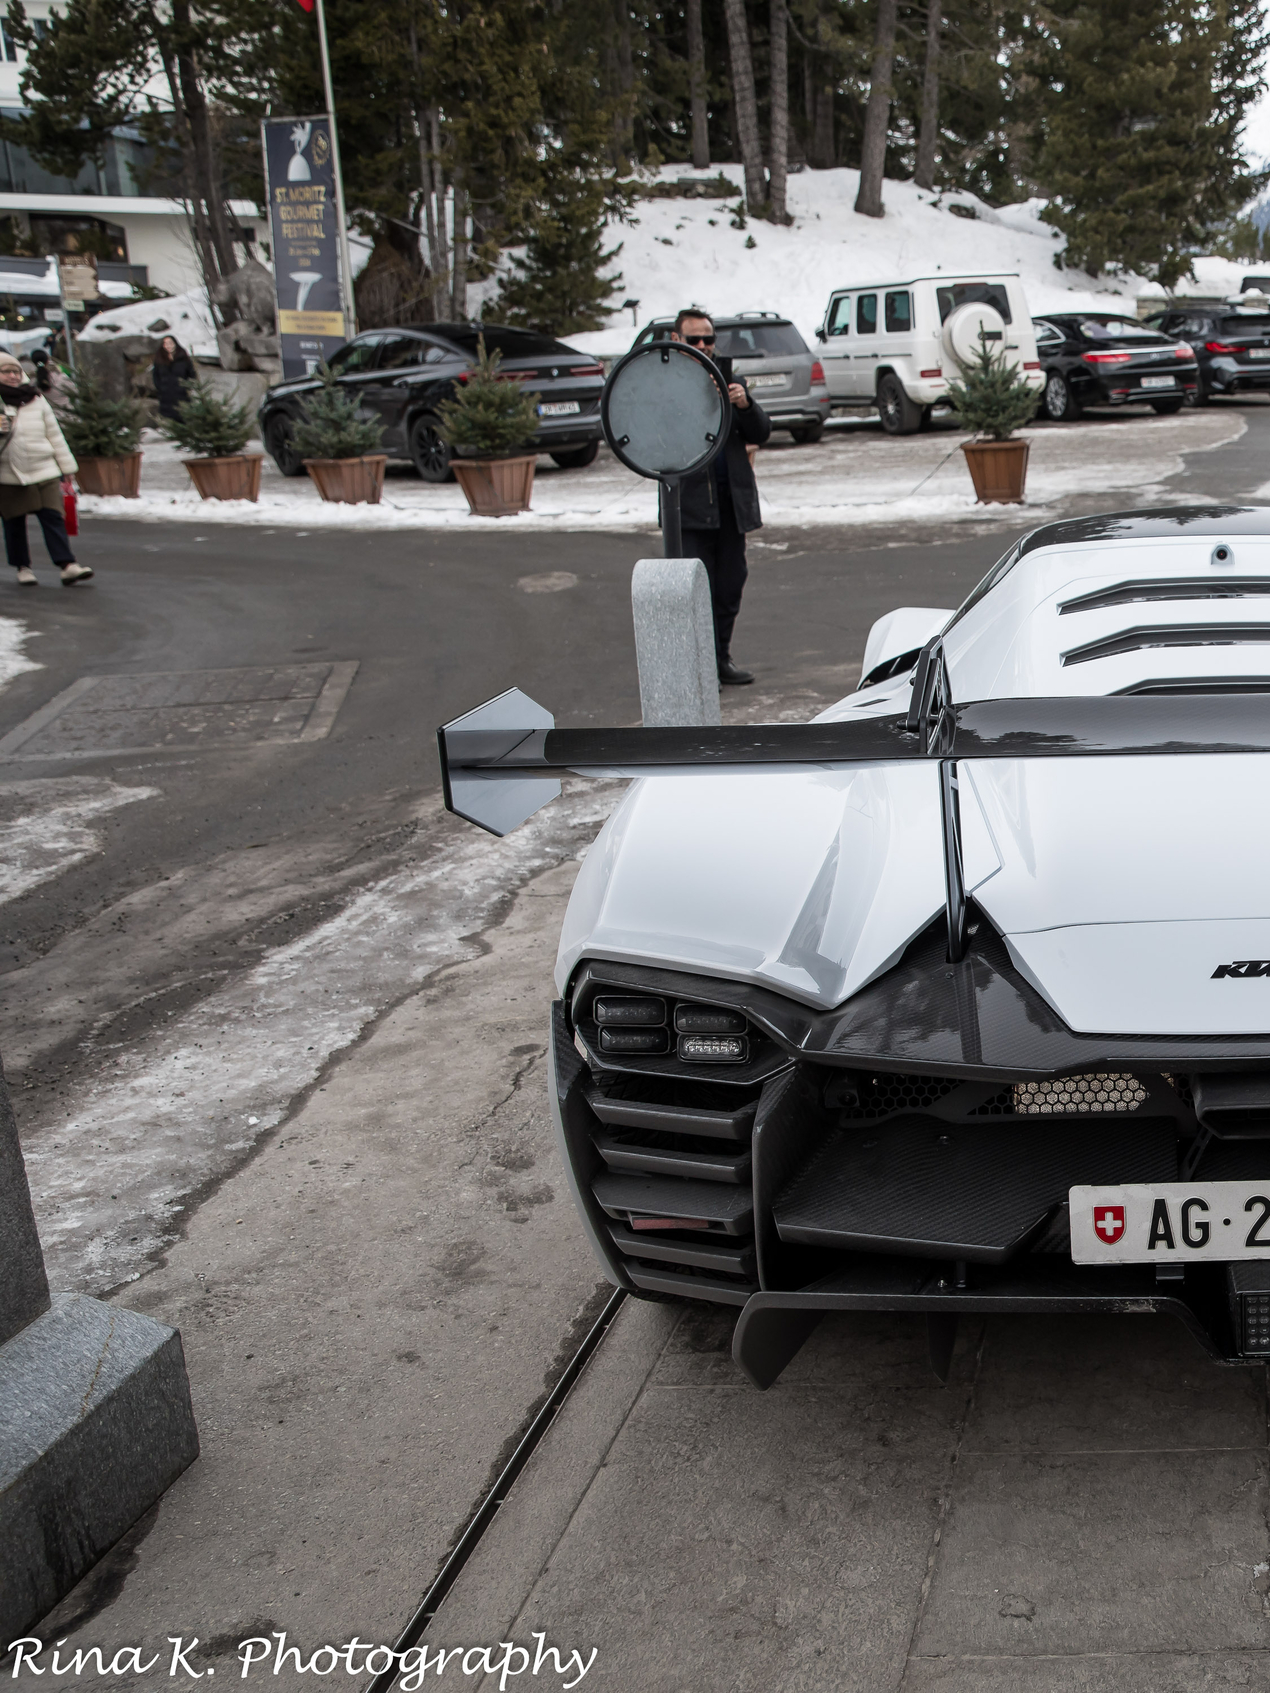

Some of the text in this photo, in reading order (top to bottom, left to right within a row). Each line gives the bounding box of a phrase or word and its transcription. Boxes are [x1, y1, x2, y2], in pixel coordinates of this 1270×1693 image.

[289, 185, 325, 202] MORITZ
[280, 204, 324, 220] GOURMET
[282, 222, 325, 238] FESTIVAL
